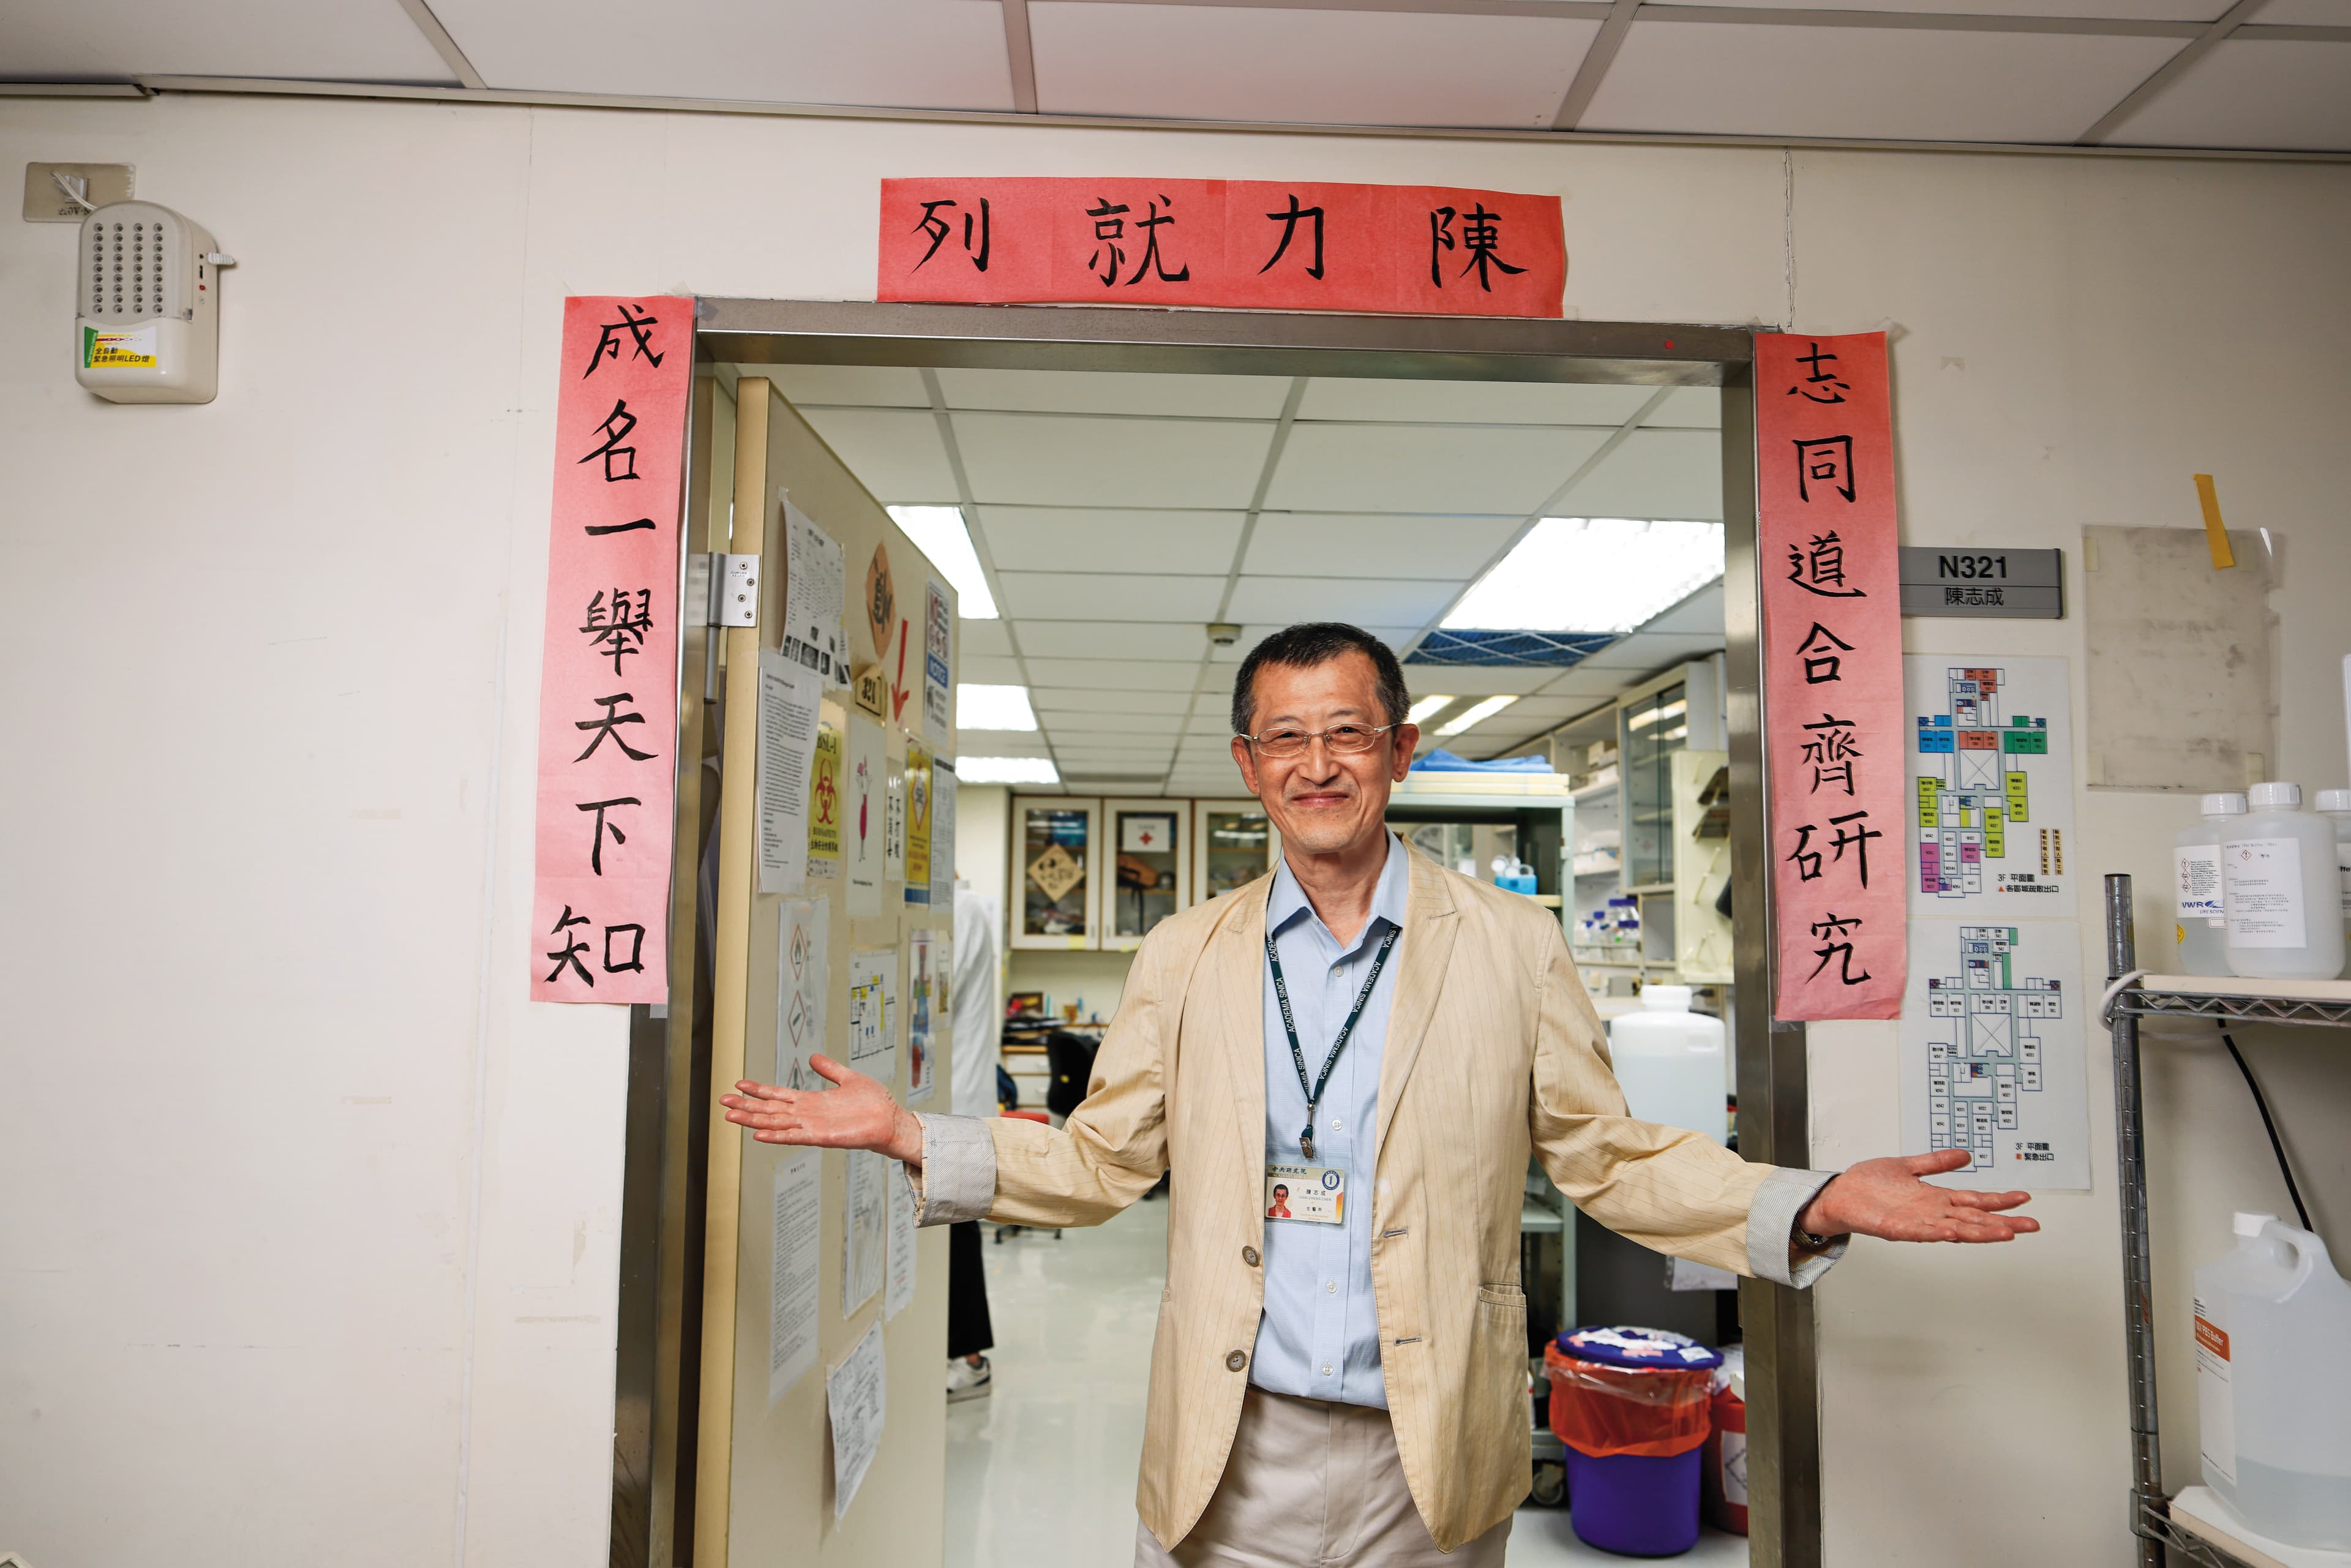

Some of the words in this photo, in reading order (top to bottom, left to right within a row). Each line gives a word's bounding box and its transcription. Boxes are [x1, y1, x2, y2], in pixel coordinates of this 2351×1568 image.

[1939, 555, 2008, 579] N321
[1946, 587, 2004, 606] 陳志成
[541, 304, 664, 988] 成名一舉天下知
[1785, 342, 1884, 986] 志同道合齊研究
[2011, 874, 2035, 883] 平面圖
[1382, 929, 1397, 948] SINICA
[1362, 961, 1381, 992] ACADEMIA
[1276, 977, 1288, 998] SINICA
[1351, 992, 1367, 1013] SINICA
[1280, 999, 1297, 1033] ACADEMIA
[1329, 1027, 1349, 1059] ACADEMIA
[1294, 1048, 1305, 1070] SINICA
[1319, 1059, 1332, 1079] SINICA
[2024, 1153, 2054, 1161] 緊急出口
[2027, 1142, 2050, 1151] 平面圖
[1272, 1166, 1307, 1175] 中央研究院
[2202, 1325, 2211, 1339] PBS
[2210, 1330, 2224, 1347] Buffer
